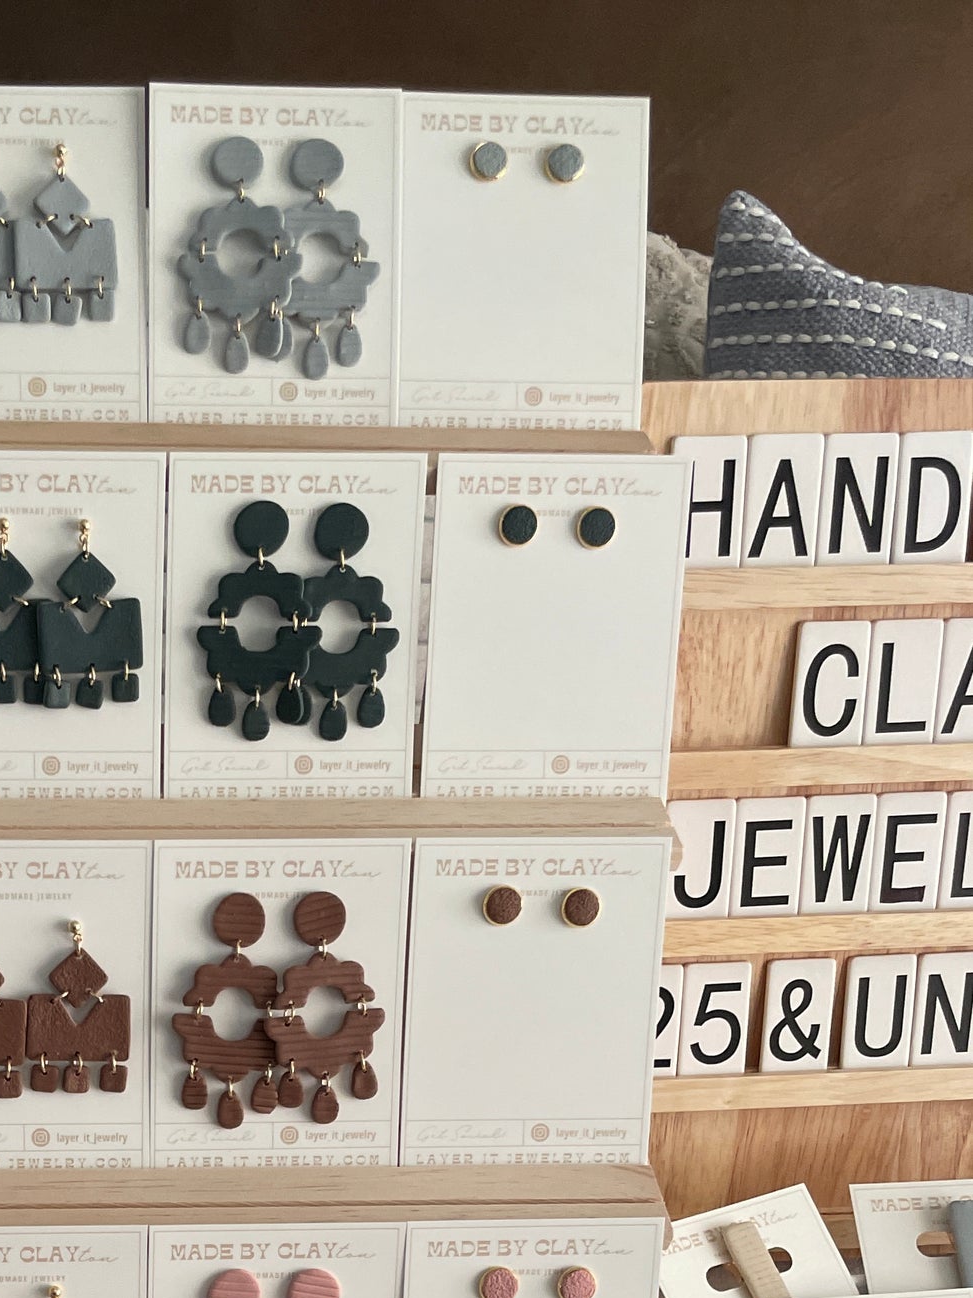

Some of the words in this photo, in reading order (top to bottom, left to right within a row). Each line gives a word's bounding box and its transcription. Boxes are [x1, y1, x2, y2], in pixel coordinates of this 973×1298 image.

[171, 105, 233, 124] MADE
[238, 107, 269, 125] BY
[421, 113, 483, 131] MADE
[488, 114, 518, 132] BY
[191, 475, 255, 494] MADE
[261, 475, 292, 494] BY
[459, 477, 521, 496] MADE
[527, 477, 557, 495] BY
[687, 456, 963, 559] HAND
[175, 860, 239, 879] MADE
[245, 860, 275, 879] BY
[435, 859, 498, 877] MADE
[504, 858, 534, 876] BY
[674, 812, 973, 910] JEWEL
[769, 979, 822, 1064] &
[870, 1197, 924, 1213] MADE
[171, 1243, 234, 1261] MADE
[240, 1243, 271, 1260] BY
[427, 1240, 491, 1258] MADE
[497, 1239, 528, 1256] BY
